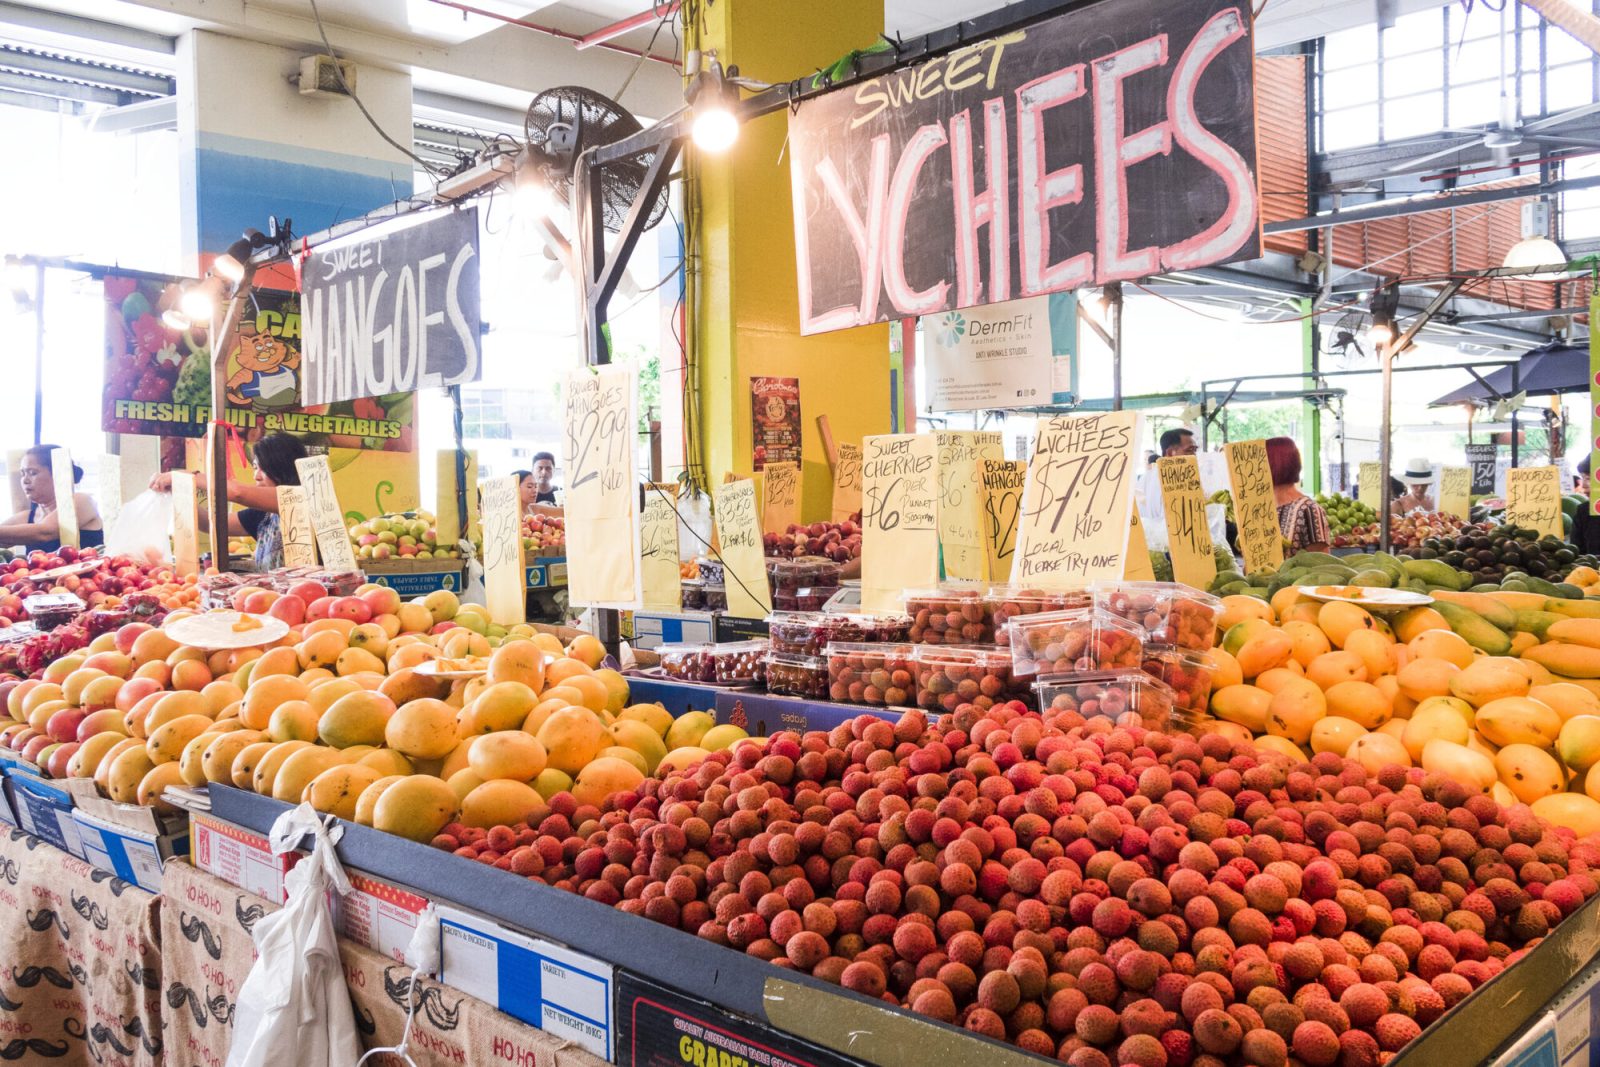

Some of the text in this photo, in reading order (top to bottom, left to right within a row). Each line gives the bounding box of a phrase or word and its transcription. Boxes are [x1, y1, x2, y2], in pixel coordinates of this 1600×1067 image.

[850, 30, 1027, 128] SWEET
[789, 7, 1258, 336] LYCHEES
[321, 236, 387, 281] SWEET
[301, 242, 477, 408] MANGOES
[969, 314, 1033, 337] DermFit
[987, 347, 1008, 358] WRINKLE
[570, 379, 600, 398] BOWEN
[566, 387, 623, 417] MANGOES
[115, 399, 189, 424] FRESH
[264, 413, 282, 431] &
[283, 413, 401, 439] VEGETABLES
[1049, 414, 1107, 431] SWEET
[564, 408, 627, 488] $2.99
[870, 438, 915, 459] SWEET
[973, 433, 1001, 446] WHITE
[864, 455, 933, 479] CHERRIES
[985, 459, 1017, 473] BOWEN
[903, 477, 928, 496] PER
[983, 472, 1025, 490] MANGOE
[1023, 451, 1128, 534] $7.99
[863, 477, 904, 531] $6
[1024, 536, 1066, 557] LOCAL
[1020, 557, 1064, 577] PLEASE
[1091, 554, 1119, 567] ONE
[212, 967, 225, 987] HO
[544, 1006, 557, 1020] NET
[557, 1013, 584, 1032] WEIGHT
[411, 1026, 429, 1048] HO
[431, 1038, 450, 1058] HO
[493, 1035, 537, 1067] HO HO
[673, 1017, 703, 1038] QUALITY
[703, 1030, 748, 1056] AUSTRALIAN
[749, 1048, 771, 1066] TABLE
